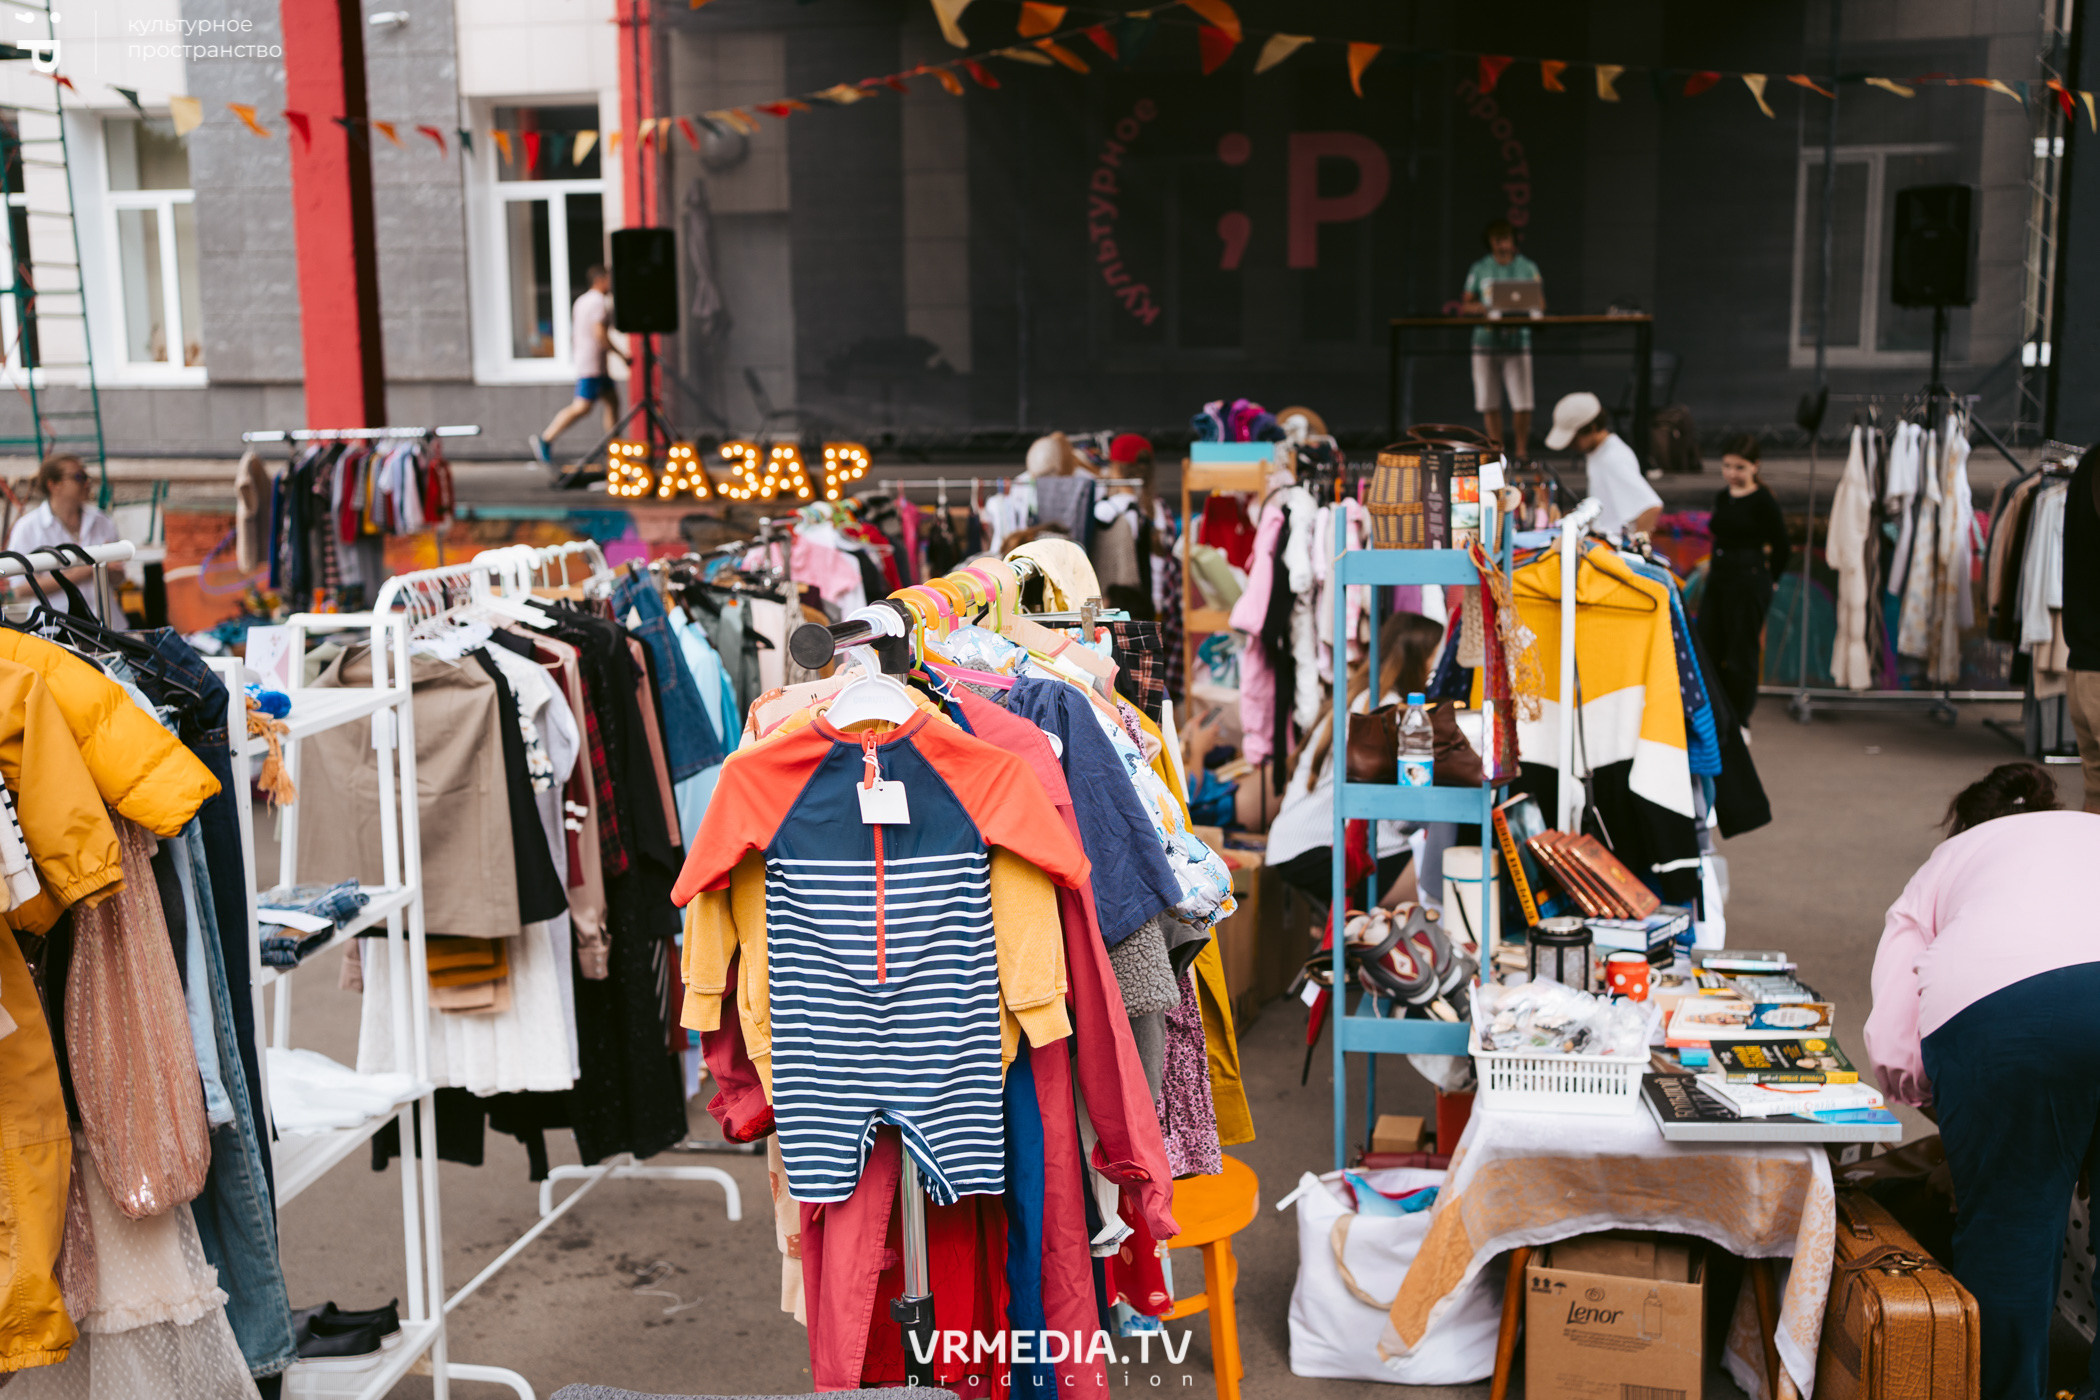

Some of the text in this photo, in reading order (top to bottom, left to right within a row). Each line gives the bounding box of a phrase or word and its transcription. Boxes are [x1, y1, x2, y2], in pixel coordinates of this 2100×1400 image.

[1087, 97, 1160, 326] культурное
[606, 438, 873, 501] БАЗАР
[1566, 1301, 1624, 1325] Lenor
